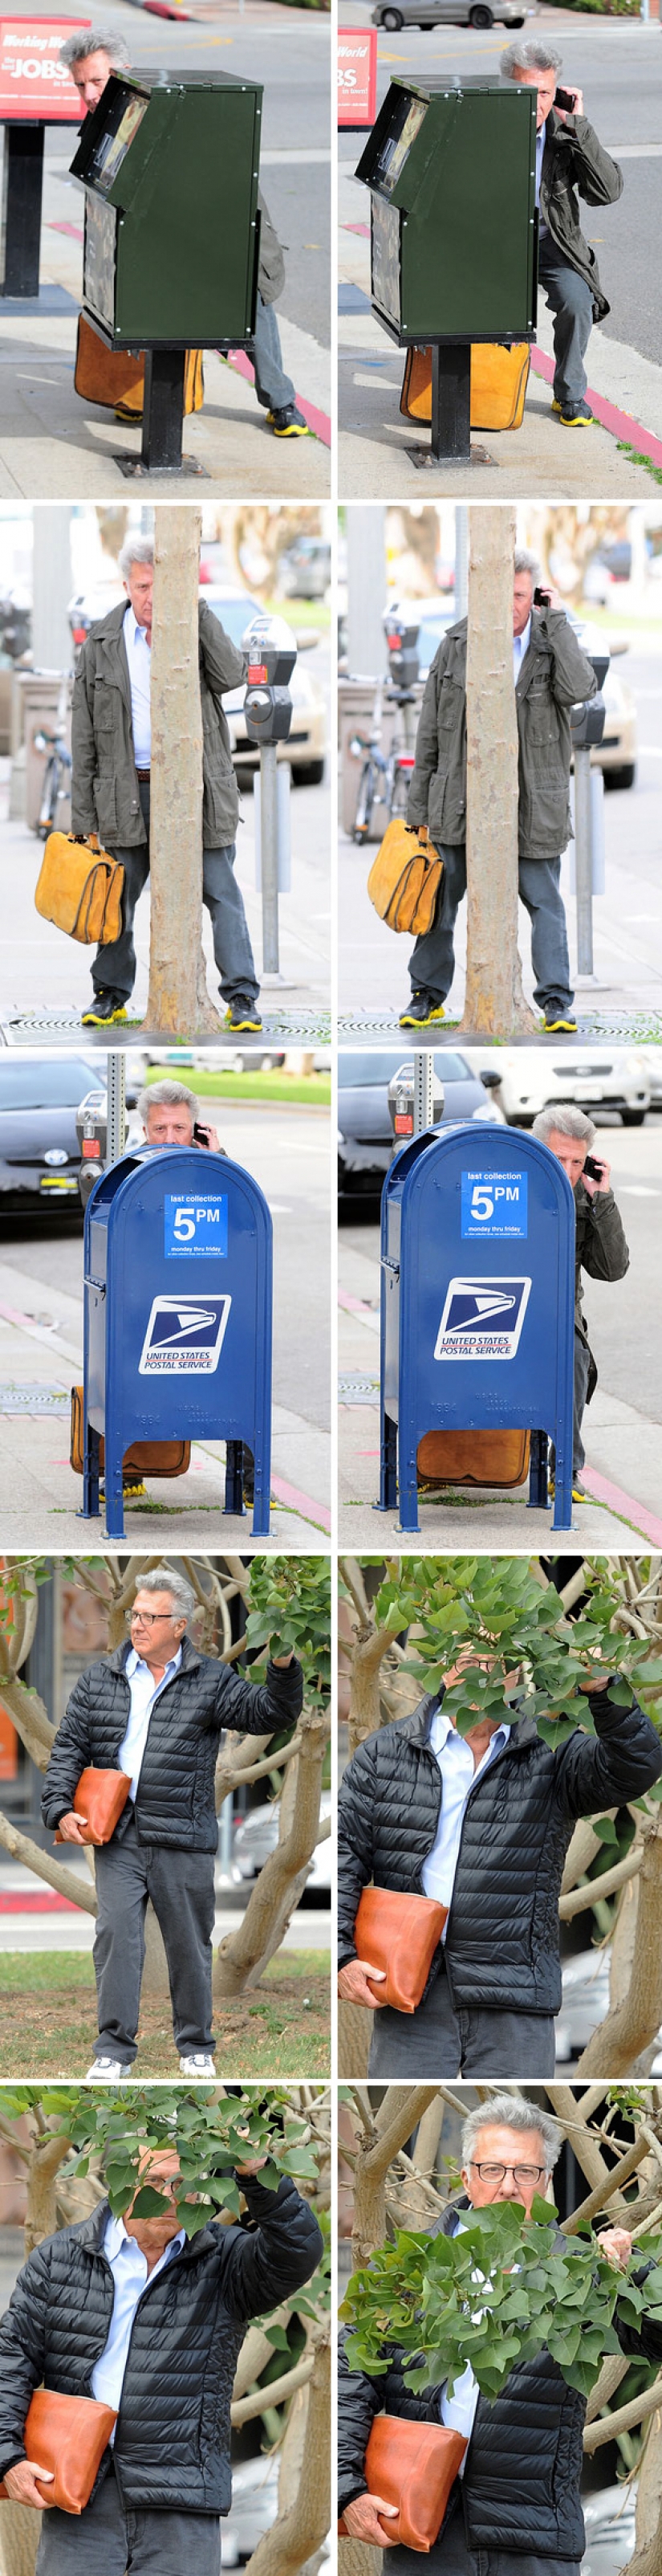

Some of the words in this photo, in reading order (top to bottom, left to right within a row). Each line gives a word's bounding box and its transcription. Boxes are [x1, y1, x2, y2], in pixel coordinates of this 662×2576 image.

[2, 35, 47, 51] Working
[338, 47, 368, 57] World
[10, 59, 70, 79] JOBS
[442, 1337, 476, 1345] UNITED
[477, 1337, 509, 1345] STATES
[441, 1347, 473, 1355] POSTAL
[144, 1361, 177, 1369] POSTAL
